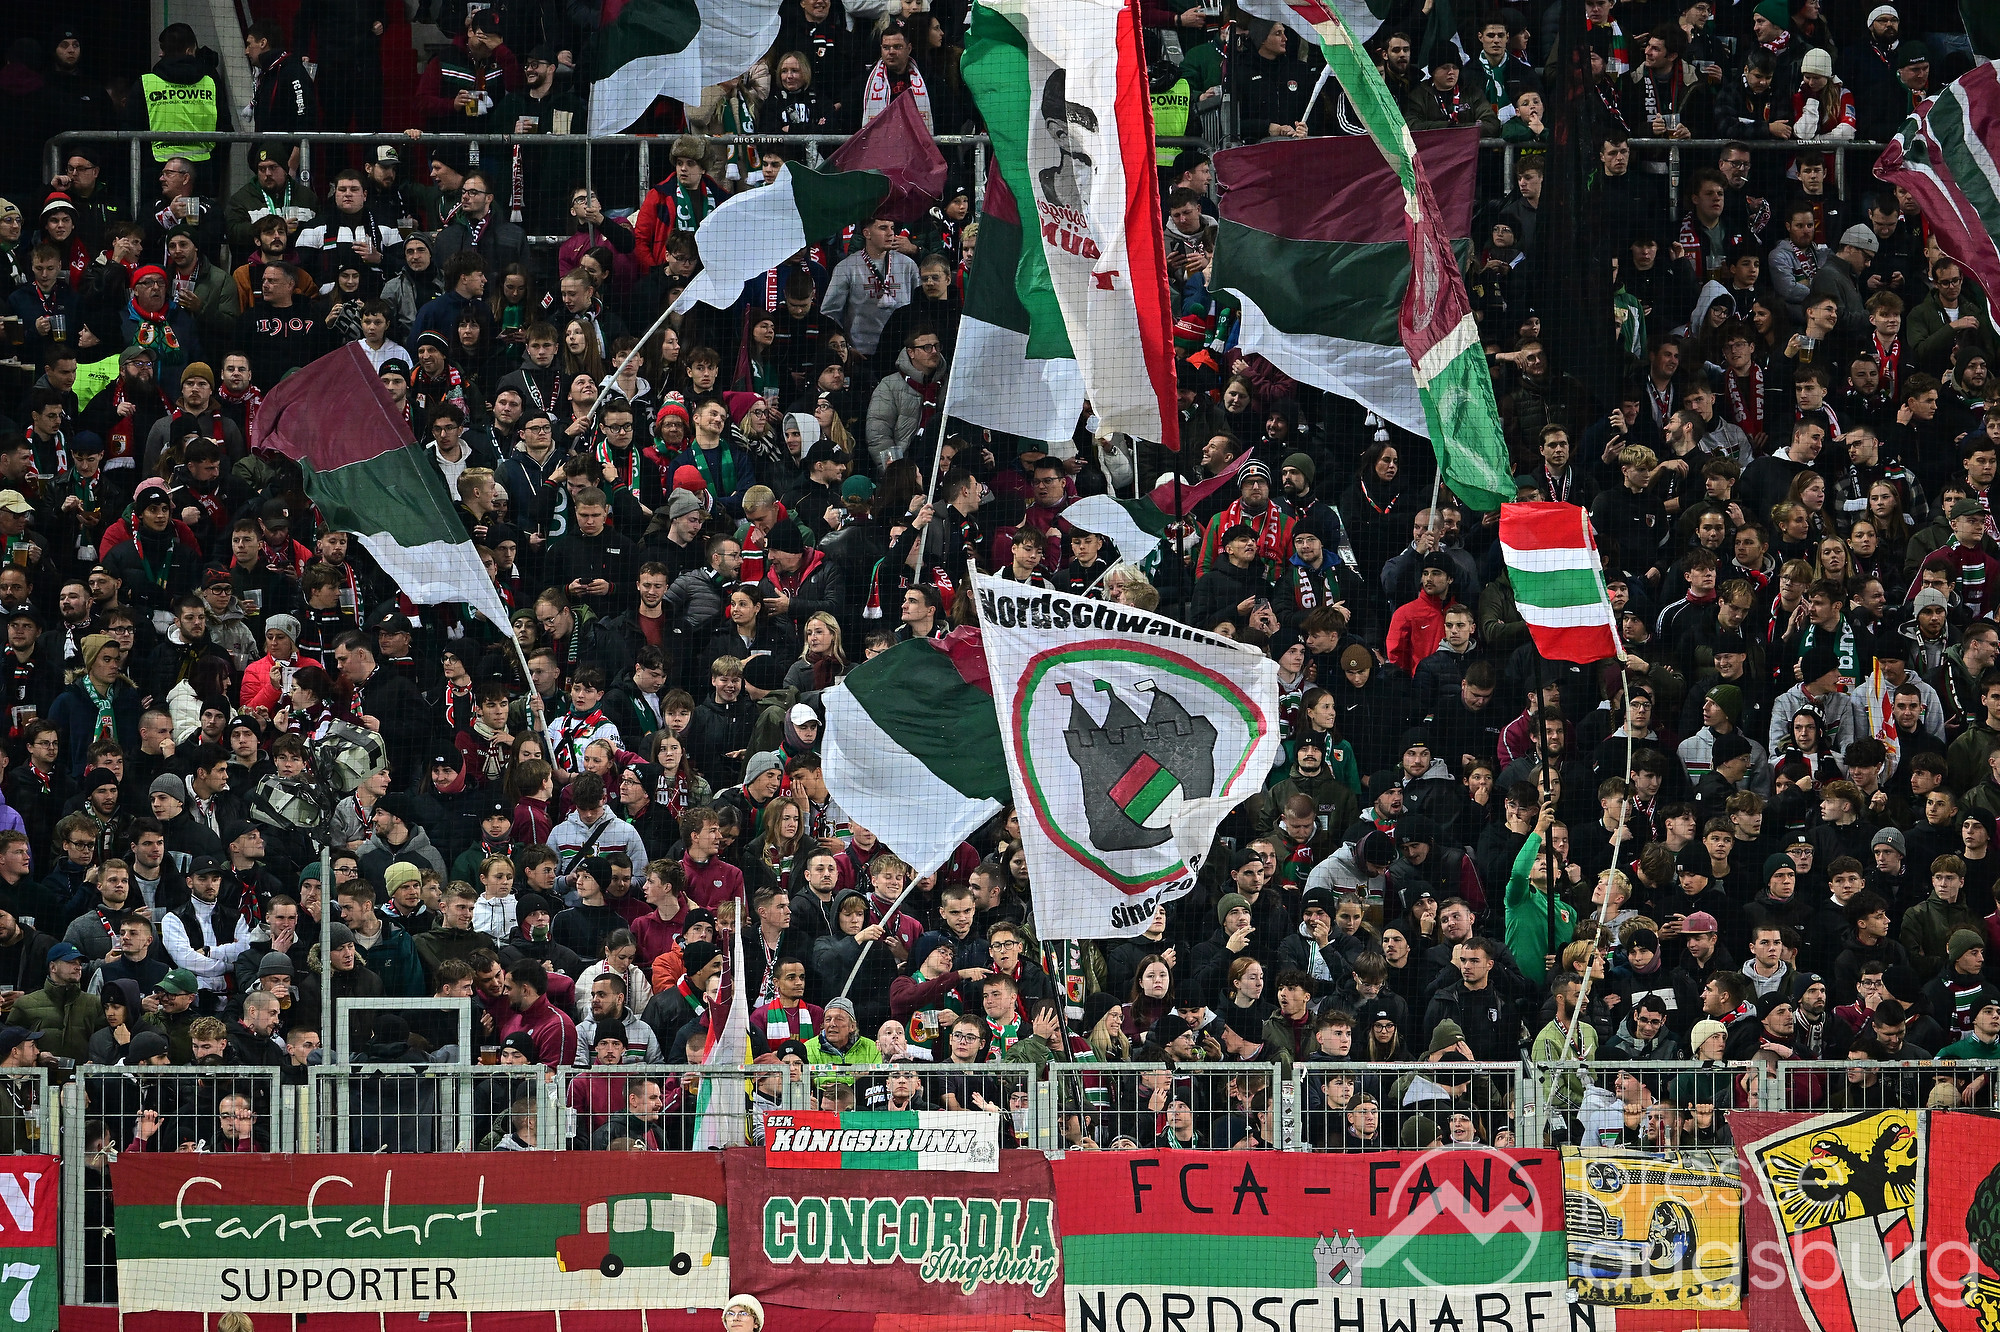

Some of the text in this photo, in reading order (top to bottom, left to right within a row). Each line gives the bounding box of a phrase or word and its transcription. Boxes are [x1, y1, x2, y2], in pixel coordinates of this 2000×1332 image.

[168, 89, 213, 101] POWER
[1150, 95, 1189, 106] POWER
[770, 1126, 977, 1154] KÖNIGSBRUNN
[0, 1171, 43, 1232] N
[158, 1169, 498, 1246] fanfahrt
[1129, 1158, 1269, 1216] FCA
[1368, 1157, 1544, 1217] FANS
[762, 1195, 1058, 1265] CONCORDIA
[0, 1262, 41, 1323] 7
[220, 1267, 458, 1302] SUPPORTER
[920, 1245, 1057, 1296] Augsburg
[1079, 1288, 1597, 1332] NORDSCHWABEN
